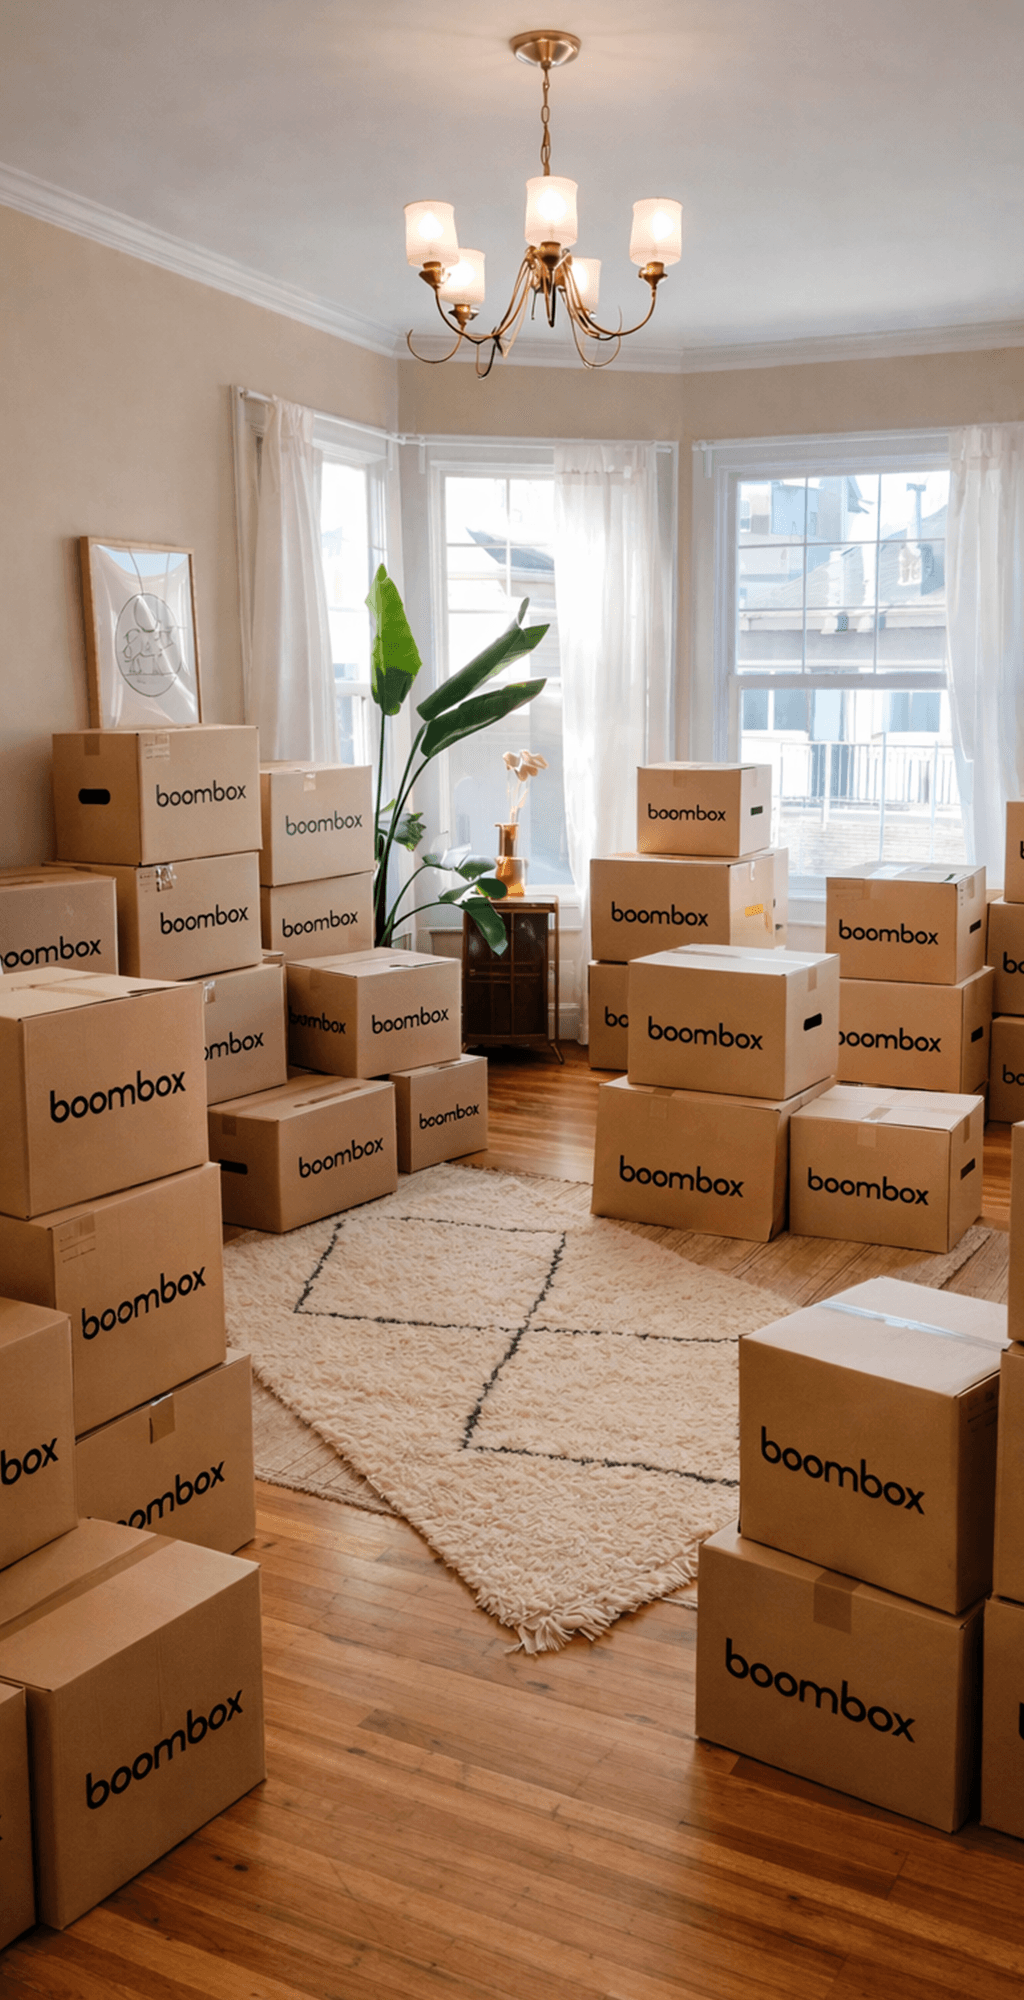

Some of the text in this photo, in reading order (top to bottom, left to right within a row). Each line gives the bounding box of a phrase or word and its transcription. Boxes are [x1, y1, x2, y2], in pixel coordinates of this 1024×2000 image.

[156, 779, 246, 808] boombox
[285, 810, 363, 837] boombox
[647, 803, 726, 822] boombox
[159, 903, 249, 936] boombox
[282, 909, 358, 938] boombox
[611, 901, 708, 927] boombox
[838, 919, 939, 945] boombox
[0, 935, 101, 968] oombox
[371, 1006, 449, 1035] boombox
[647, 1015, 763, 1050] boombox
[204, 1031, 264, 1061] mbox
[49, 1070, 186, 1124] boombox
[419, 1104, 479, 1130] boombox
[298, 1138, 384, 1179] boombox
[619, 1154, 744, 1198] boombox
[807, 1167, 929, 1206] boombox
[81, 1266, 206, 1340] boombox
[761, 1425, 925, 1515] boombox
[117, 1461, 225, 1530] ombox
[724, 1637, 916, 1743] boombox
[84, 1689, 244, 1811] boombox
